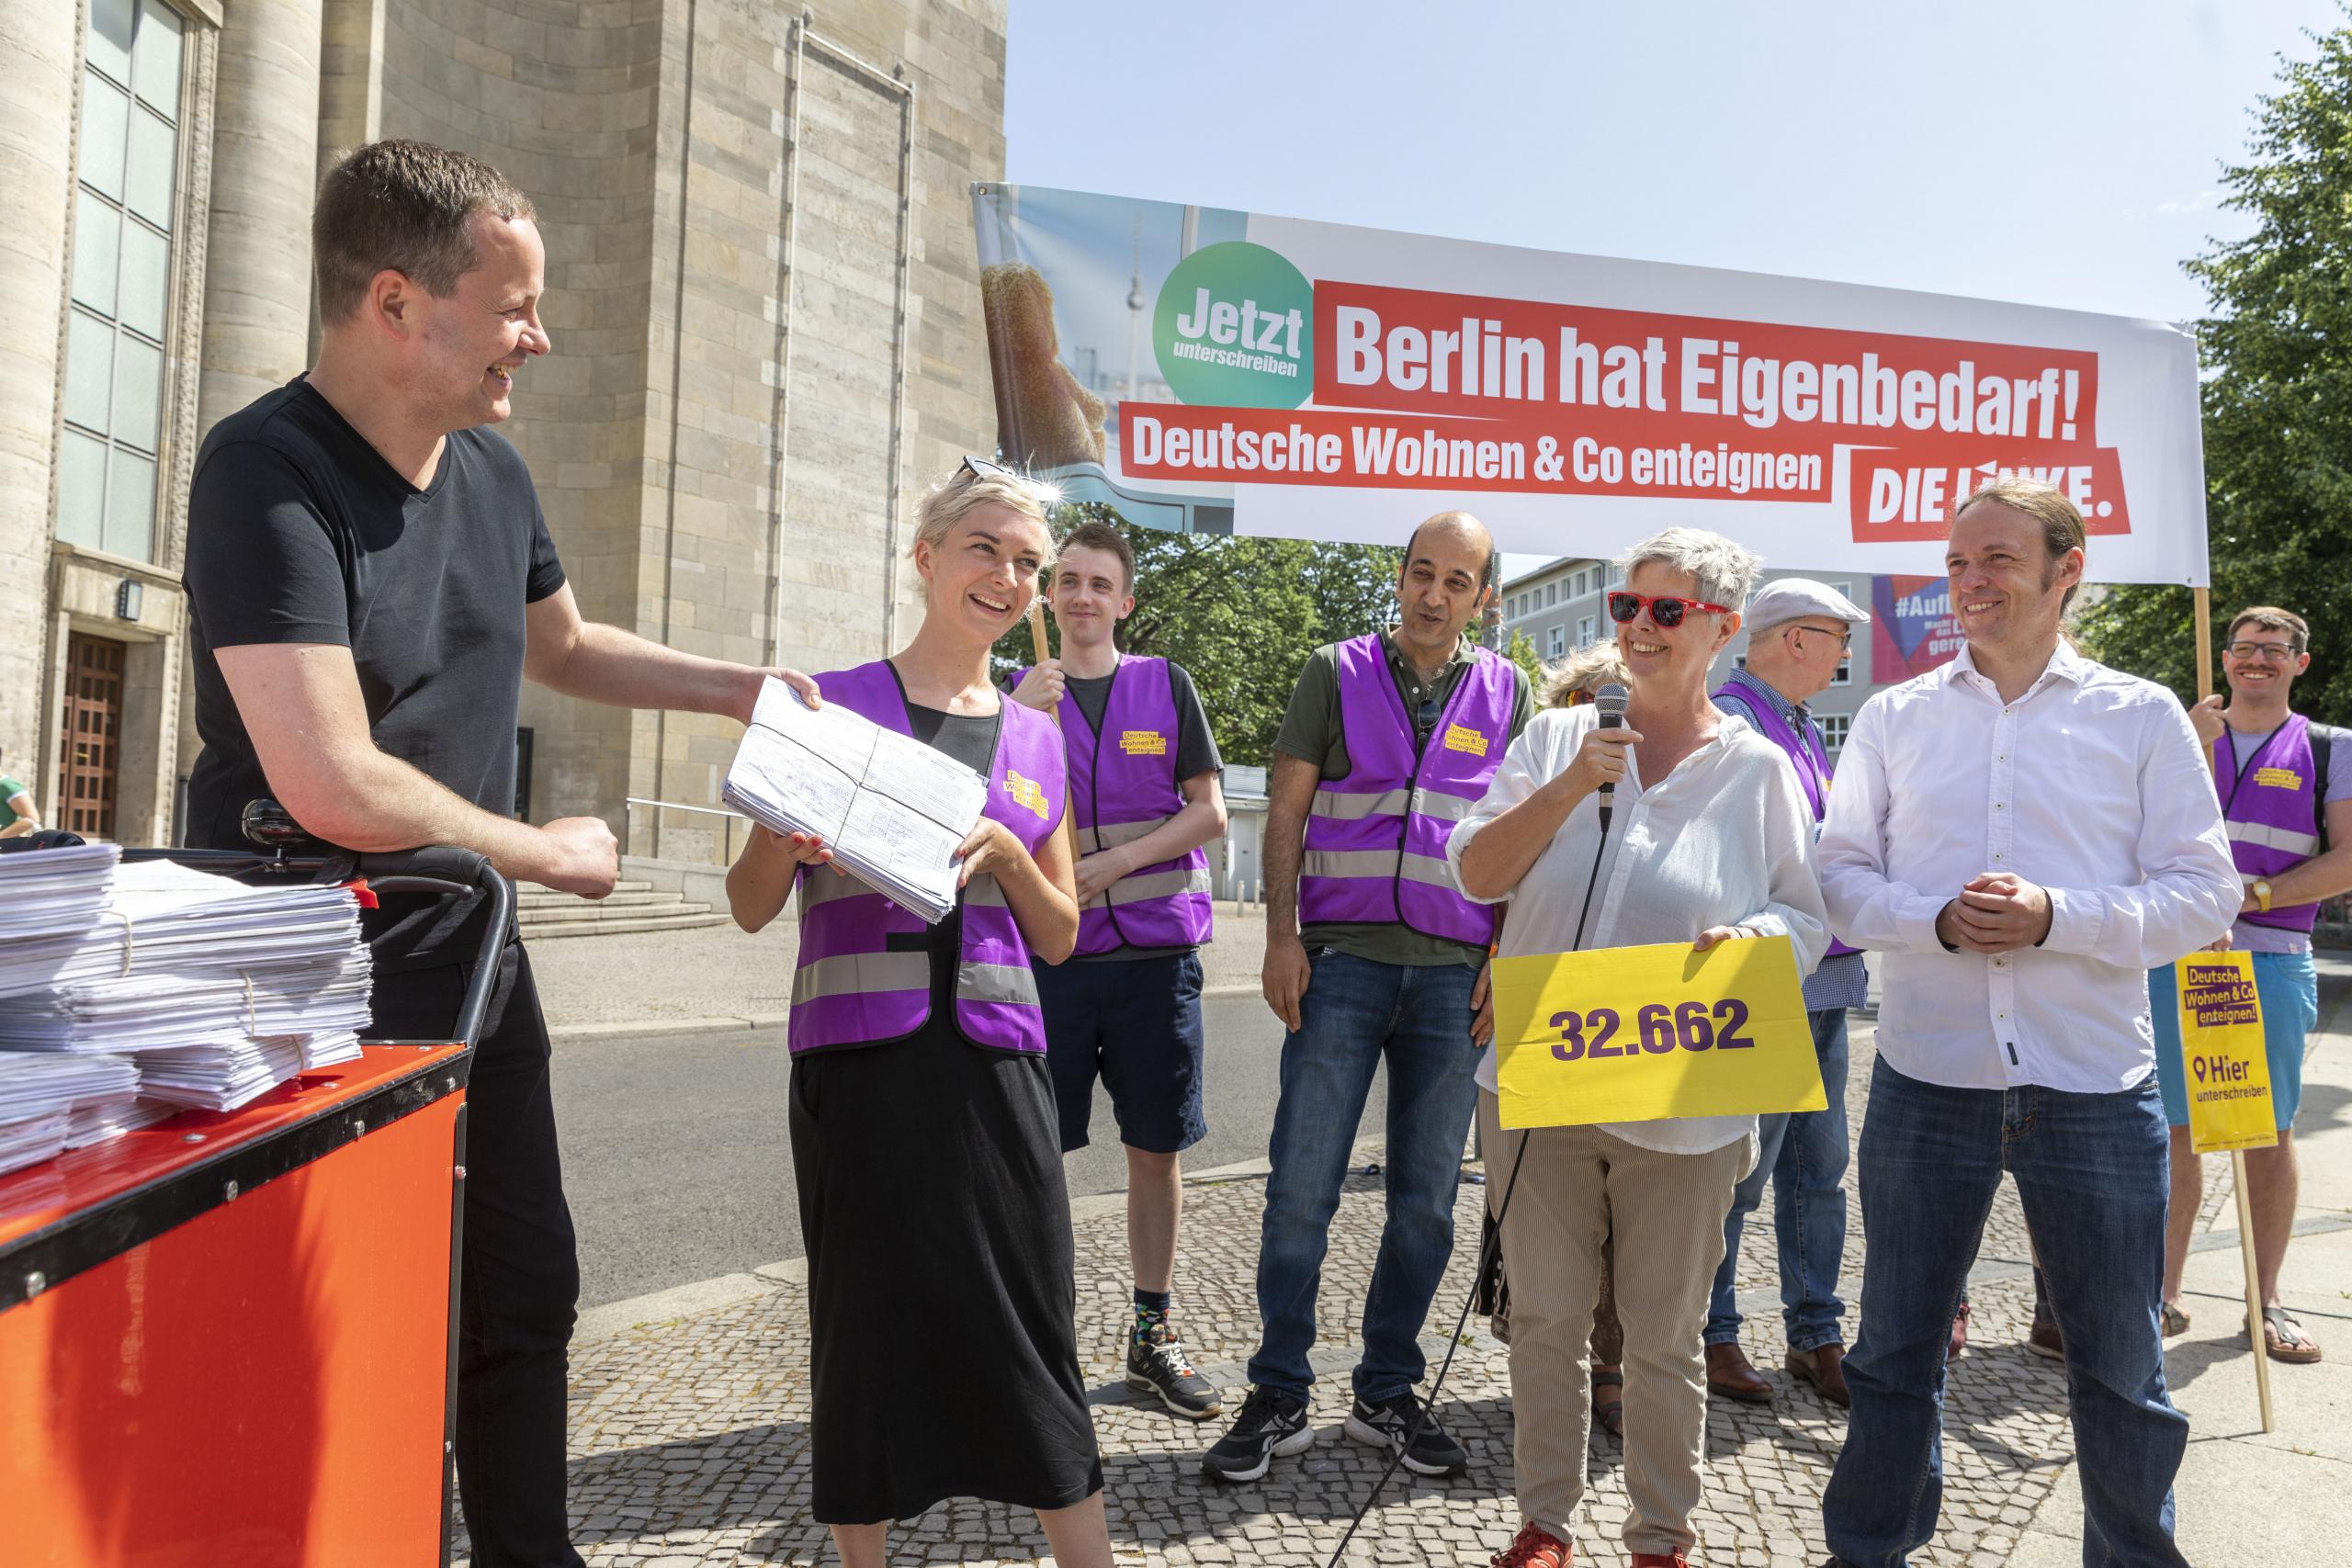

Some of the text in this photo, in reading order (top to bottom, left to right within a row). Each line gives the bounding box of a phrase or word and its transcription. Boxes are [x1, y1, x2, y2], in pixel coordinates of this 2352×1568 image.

[1175, 287, 1303, 359] Jetzt
[1172, 341, 1298, 378] unterschreiben
[1336, 304, 2080, 442] Berlin hat Eigenbedarf!
[1131, 415, 1822, 494] Deutsche Wohnen & Co enteignen
[1868, 467, 1949, 524] DIE
[2189, 967, 2240, 984] Deutsche
[2186, 985, 2255, 1007] Wohnen & Co
[1549, 998, 1755, 1061] 32.662
[2199, 1005, 2256, 1025] enteignen!
[2210, 1055, 2250, 1083] Hier
[2196, 1086, 2267, 1102] unterschreiben
